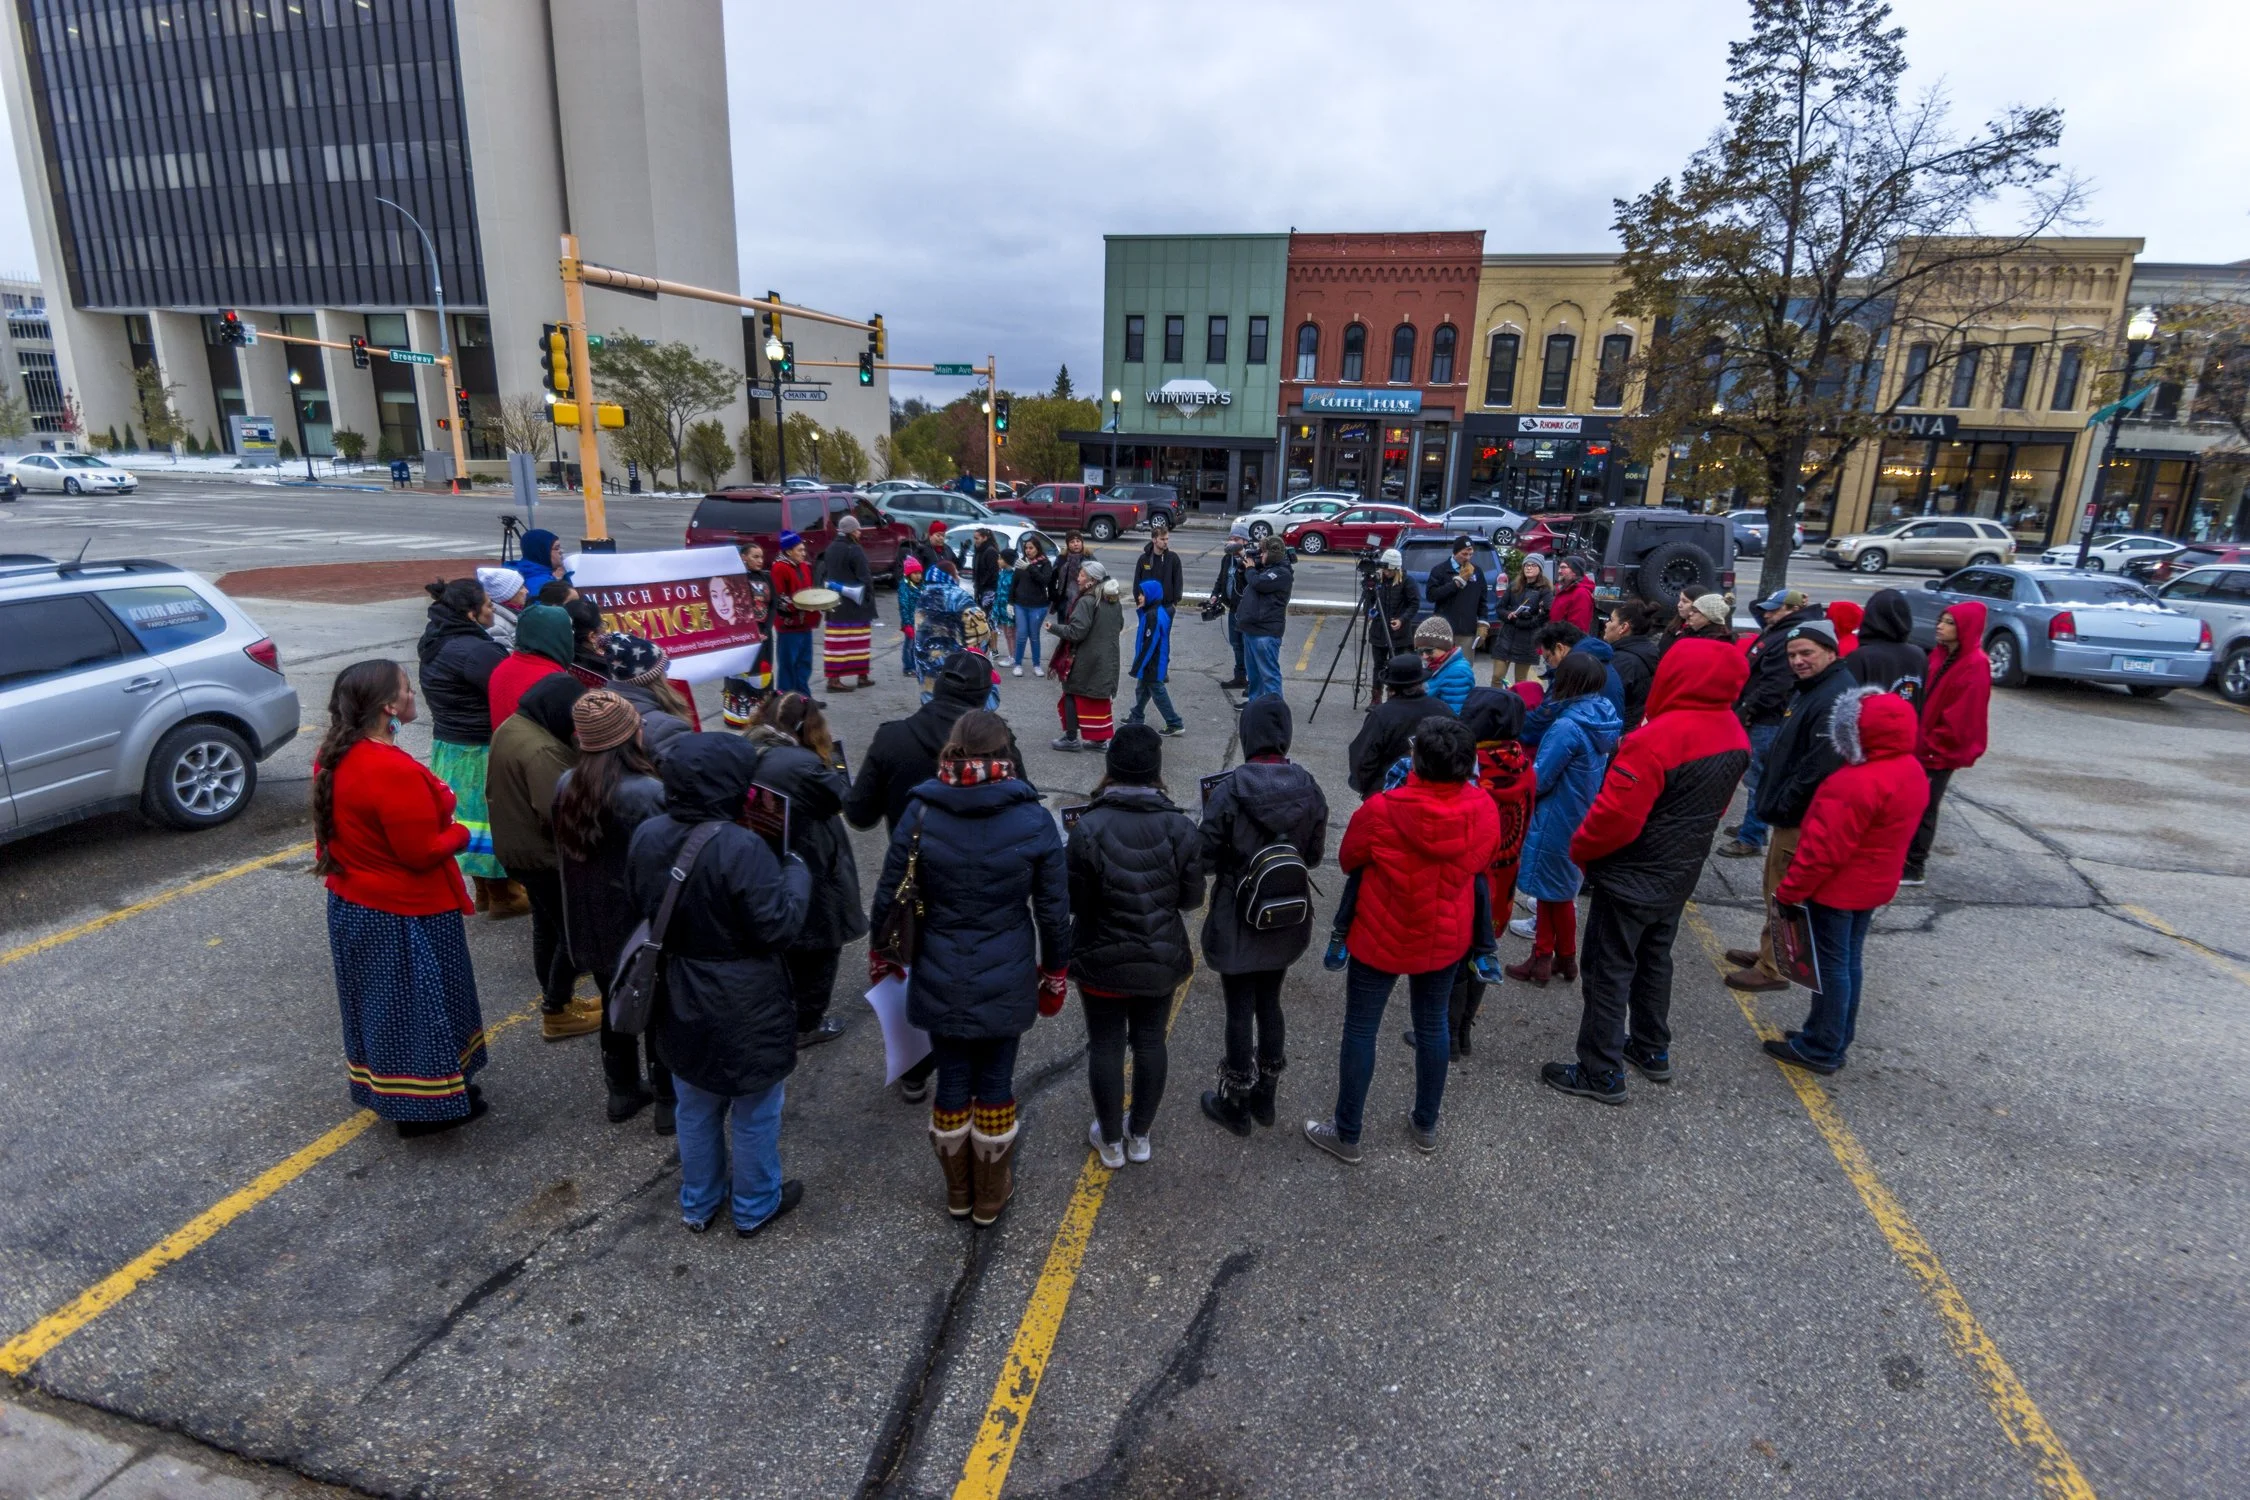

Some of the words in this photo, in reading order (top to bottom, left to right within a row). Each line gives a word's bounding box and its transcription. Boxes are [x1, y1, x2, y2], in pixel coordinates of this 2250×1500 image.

[392, 351, 432, 364] Broadway
[935, 365, 953, 374] Main
[958, 366, 972, 374] Ave
[1145, 391, 1232, 404] WIMMER'S
[1320, 397, 1365, 408] COFFEE
[1373, 399, 1413, 409] HOUSE
[584, 589, 653, 607] MARCH
[662, 584, 702, 600] FOR
[128, 604, 168, 621] KVRR
[165, 599, 205, 616] NEWS
[600, 602, 715, 640] USTICE
[666, 643, 697, 655] Murdered
[696, 639, 732, 650] Indigenous
